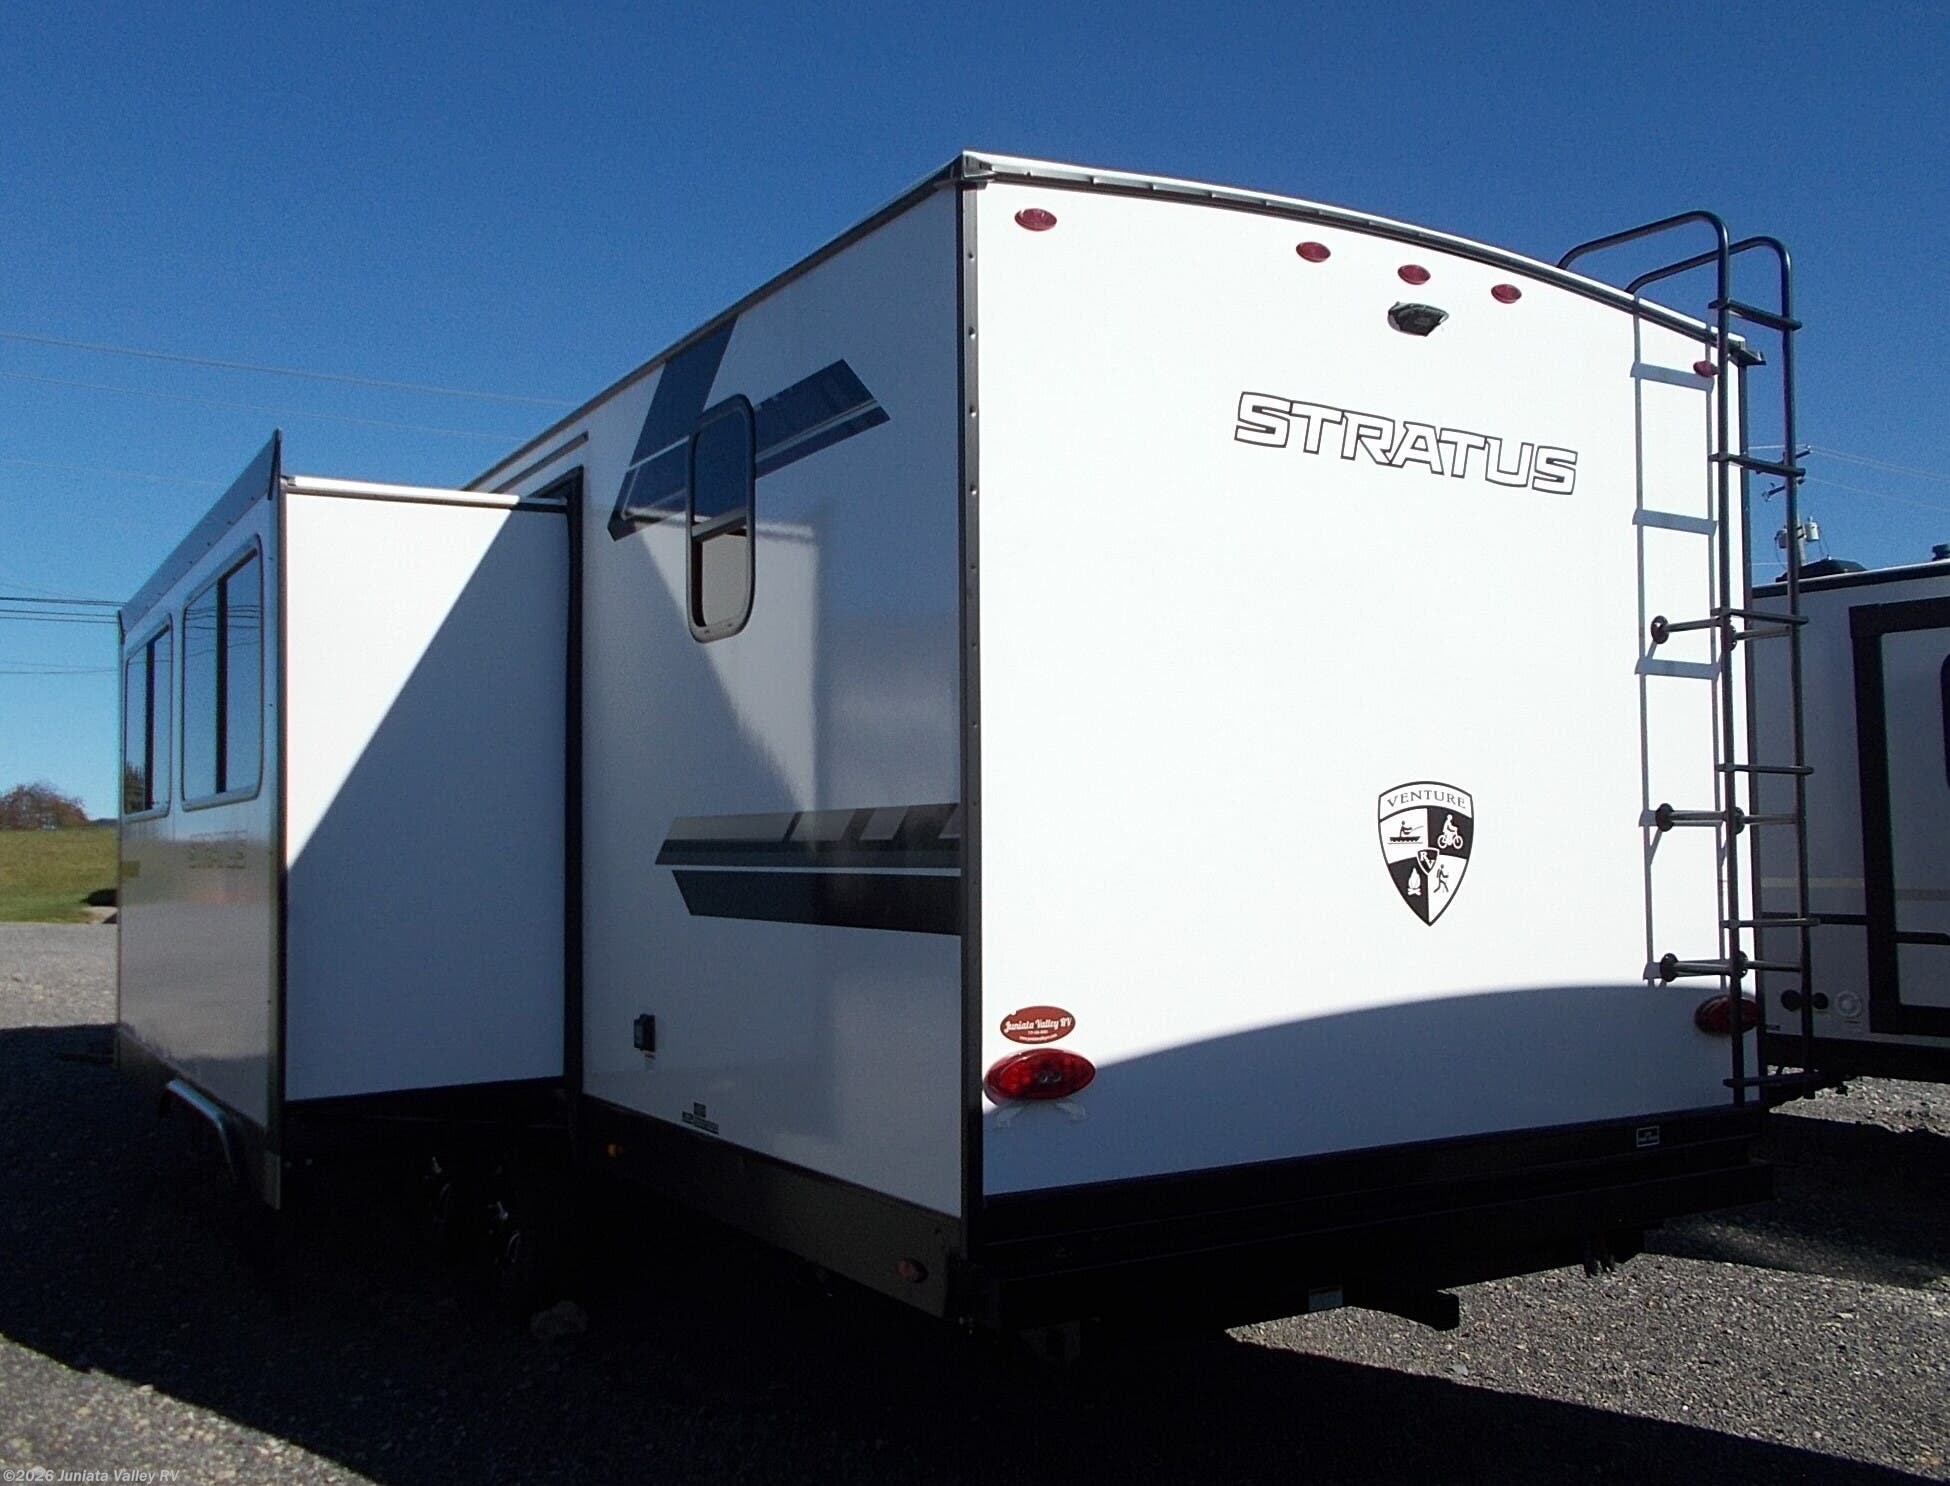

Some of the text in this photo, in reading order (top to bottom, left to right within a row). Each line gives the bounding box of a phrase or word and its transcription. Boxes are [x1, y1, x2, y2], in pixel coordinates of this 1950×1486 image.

[1233, 391, 1578, 496] STRATUS
[1387, 790, 1466, 809] VENTURE
[1420, 851, 1436, 870] RV
[1004, 1021, 1034, 1033] Juniata
[1035, 1018, 1059, 1030] Valley
[1060, 1017, 1072, 1027] RV
